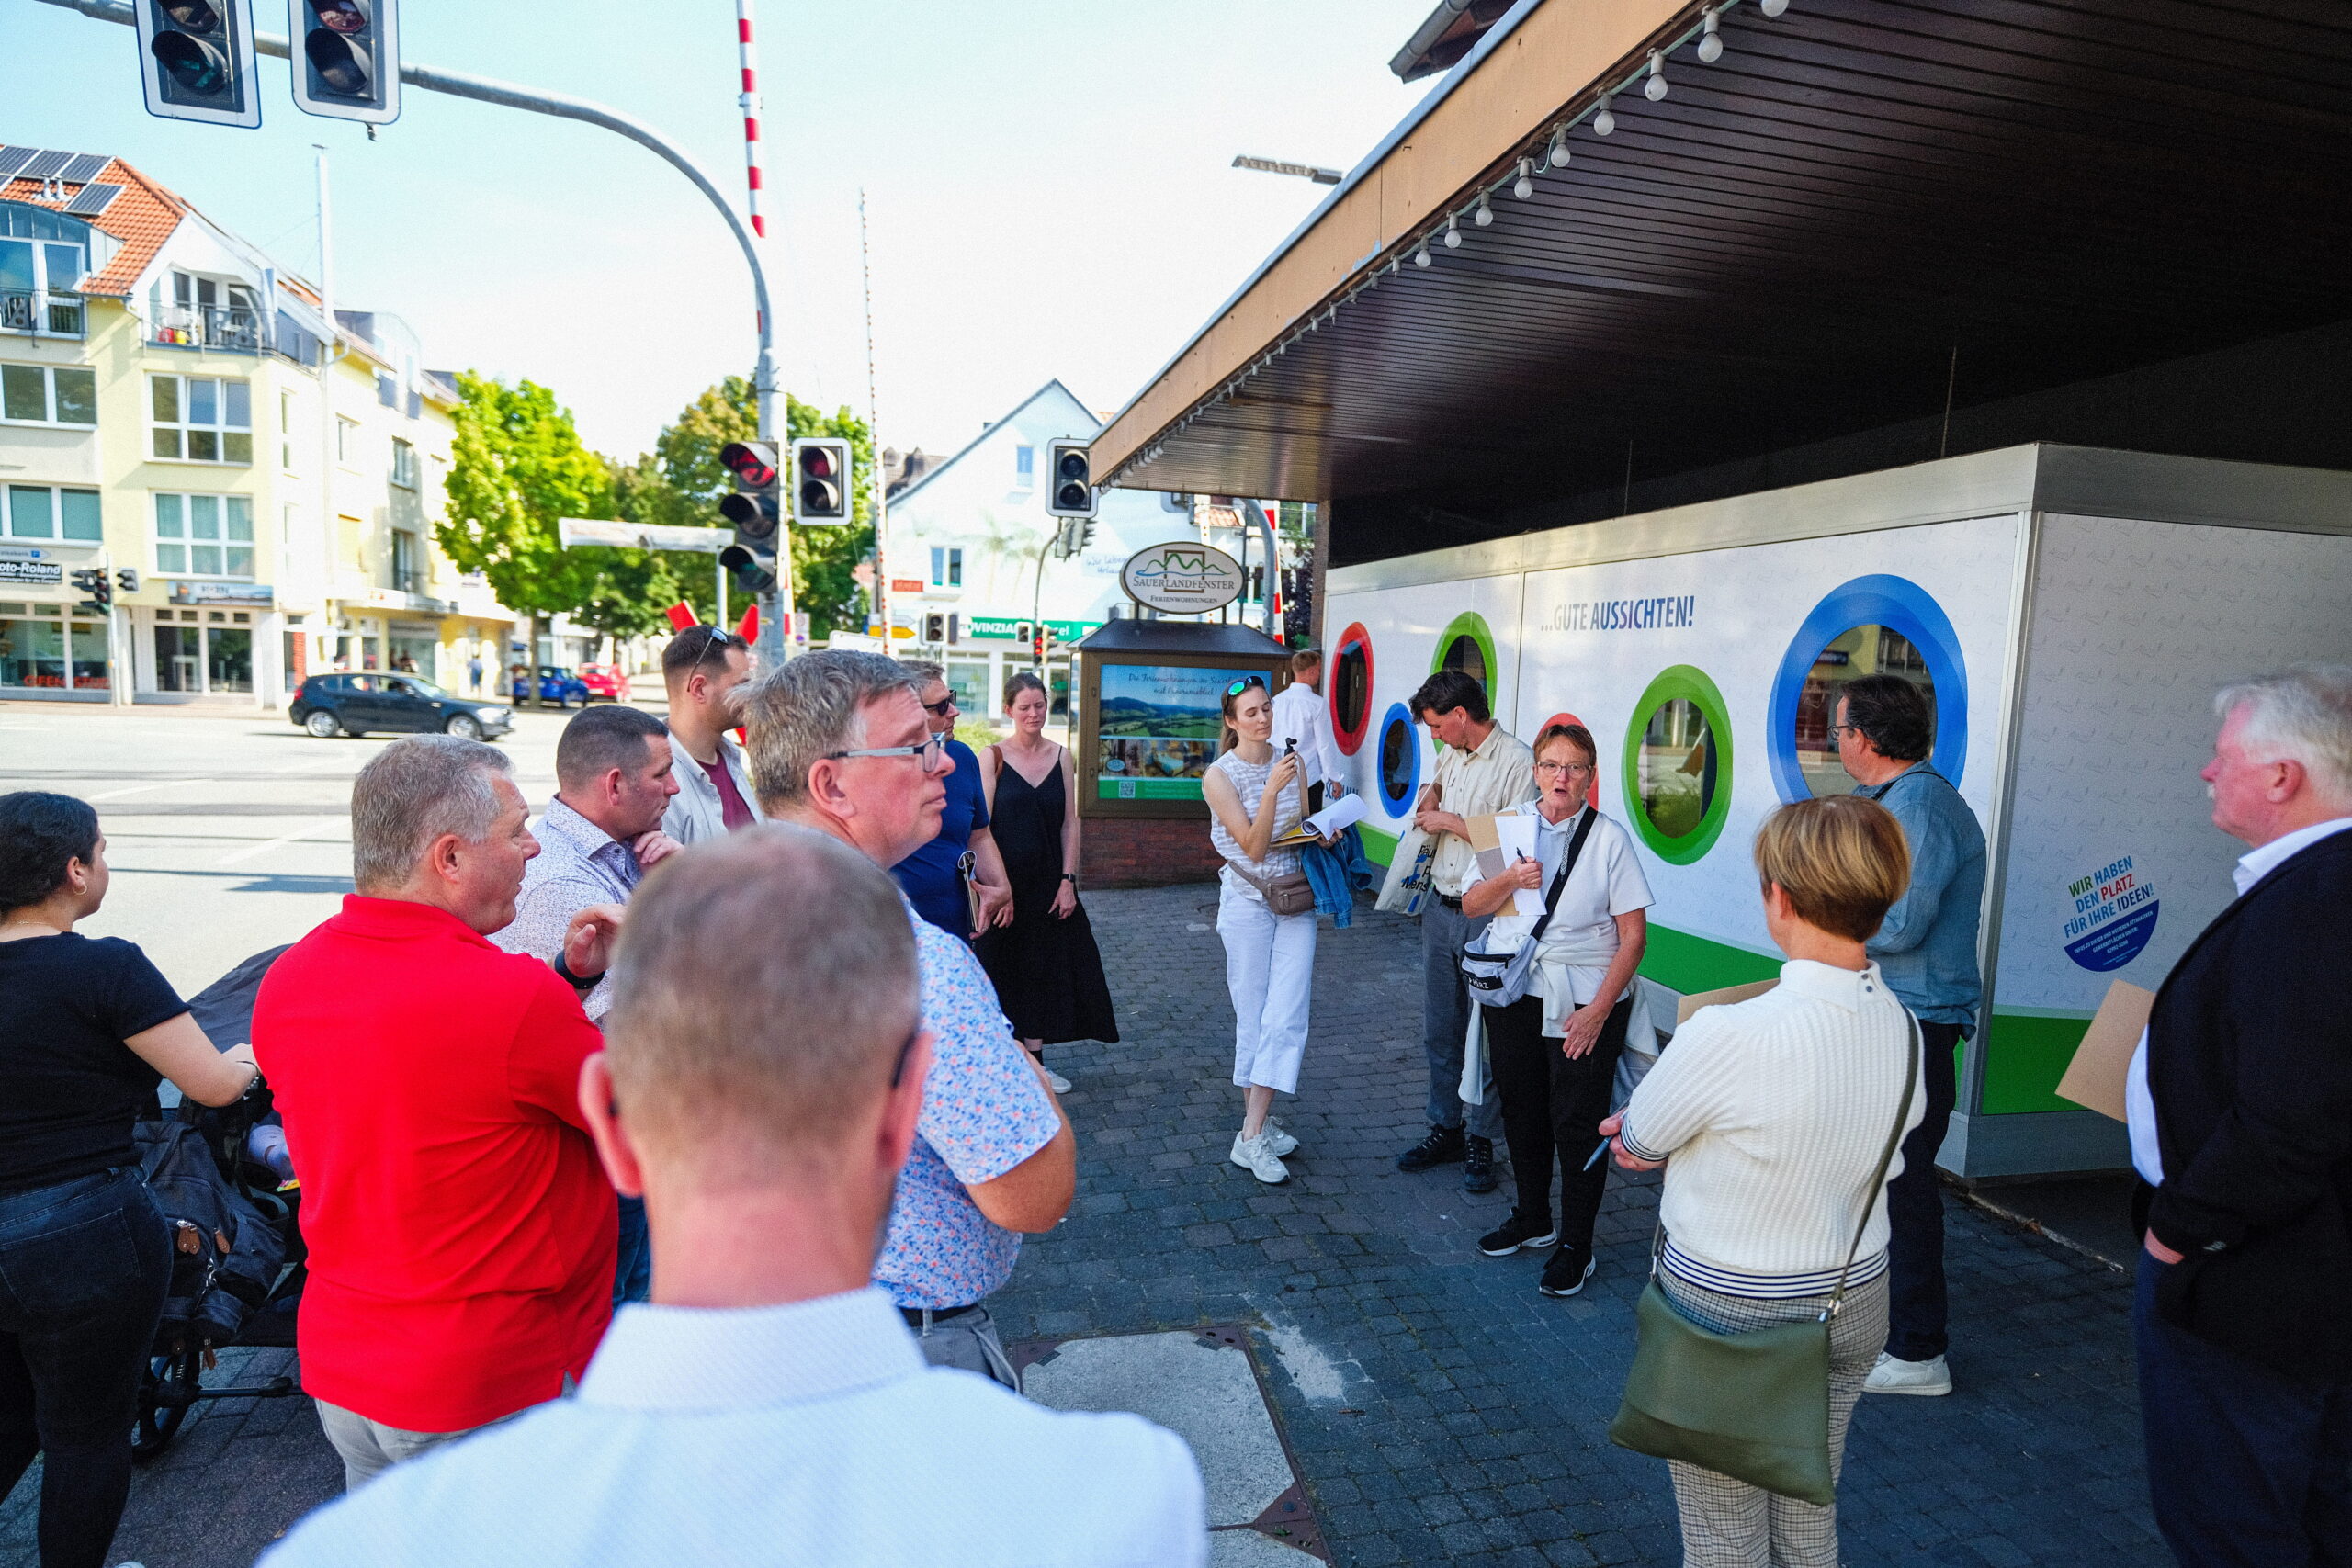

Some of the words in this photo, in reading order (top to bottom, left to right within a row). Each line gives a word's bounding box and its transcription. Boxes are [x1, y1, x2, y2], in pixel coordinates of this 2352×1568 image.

[0, 562, 61, 575] oto-Roland
[1133, 576, 1235, 591] SAUERLANDFENSTER
[1590, 595, 1695, 630] AUSSICHTEN!
[2068, 876, 2093, 897] WIR
[2094, 855, 2133, 886] HABEN
[2075, 891, 2100, 913] DEN
[2100, 874, 2135, 901] PLATZ
[2064, 918, 2087, 938] FÜR
[2088, 902, 2116, 926] IHRE
[2117, 882, 2154, 911] IDEEN!
